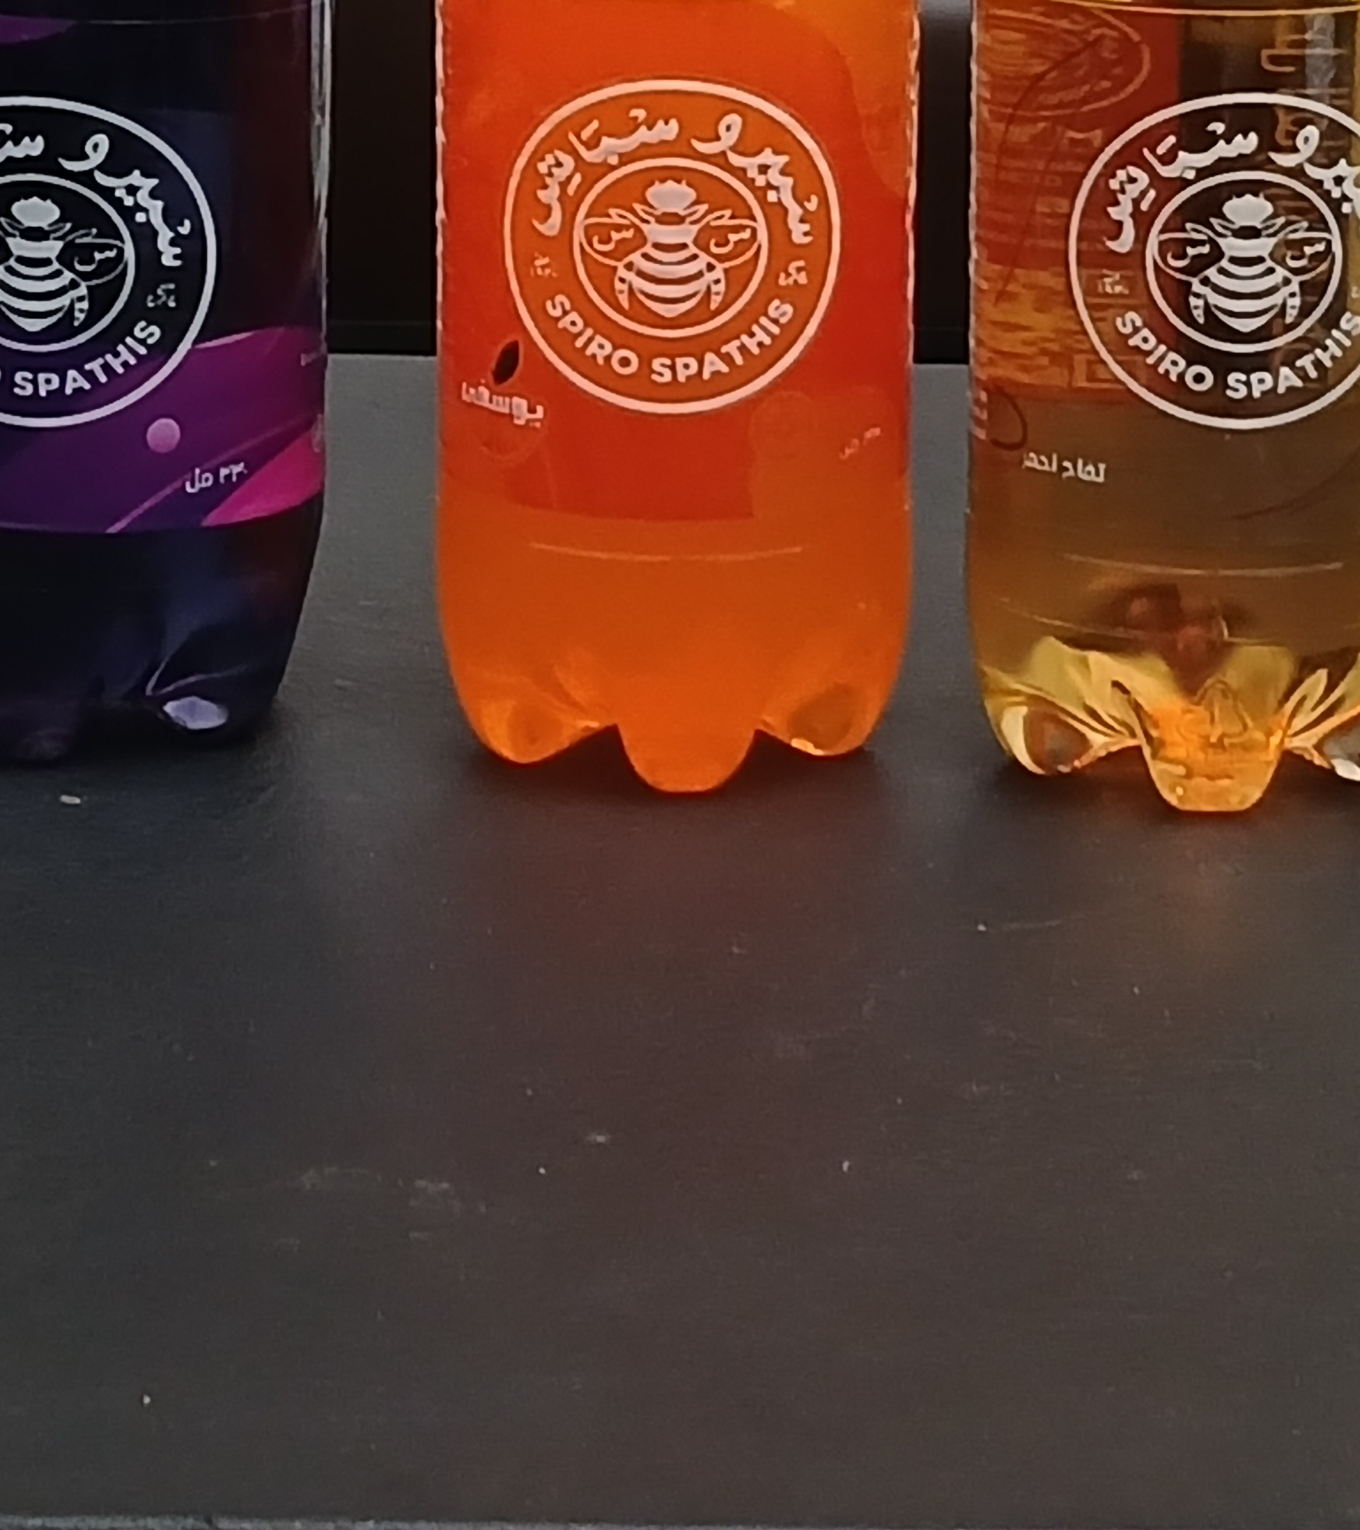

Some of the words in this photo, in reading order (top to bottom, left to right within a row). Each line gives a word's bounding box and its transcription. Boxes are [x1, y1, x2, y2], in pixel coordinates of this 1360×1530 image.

[12, 319, 162, 398] SPATHIS
[544, 293, 639, 376] SPIRO
[651, 298, 794, 383] SPATHIS
[1115, 310, 1215, 392] SPIRO
[185, 467, 214, 493] مل
